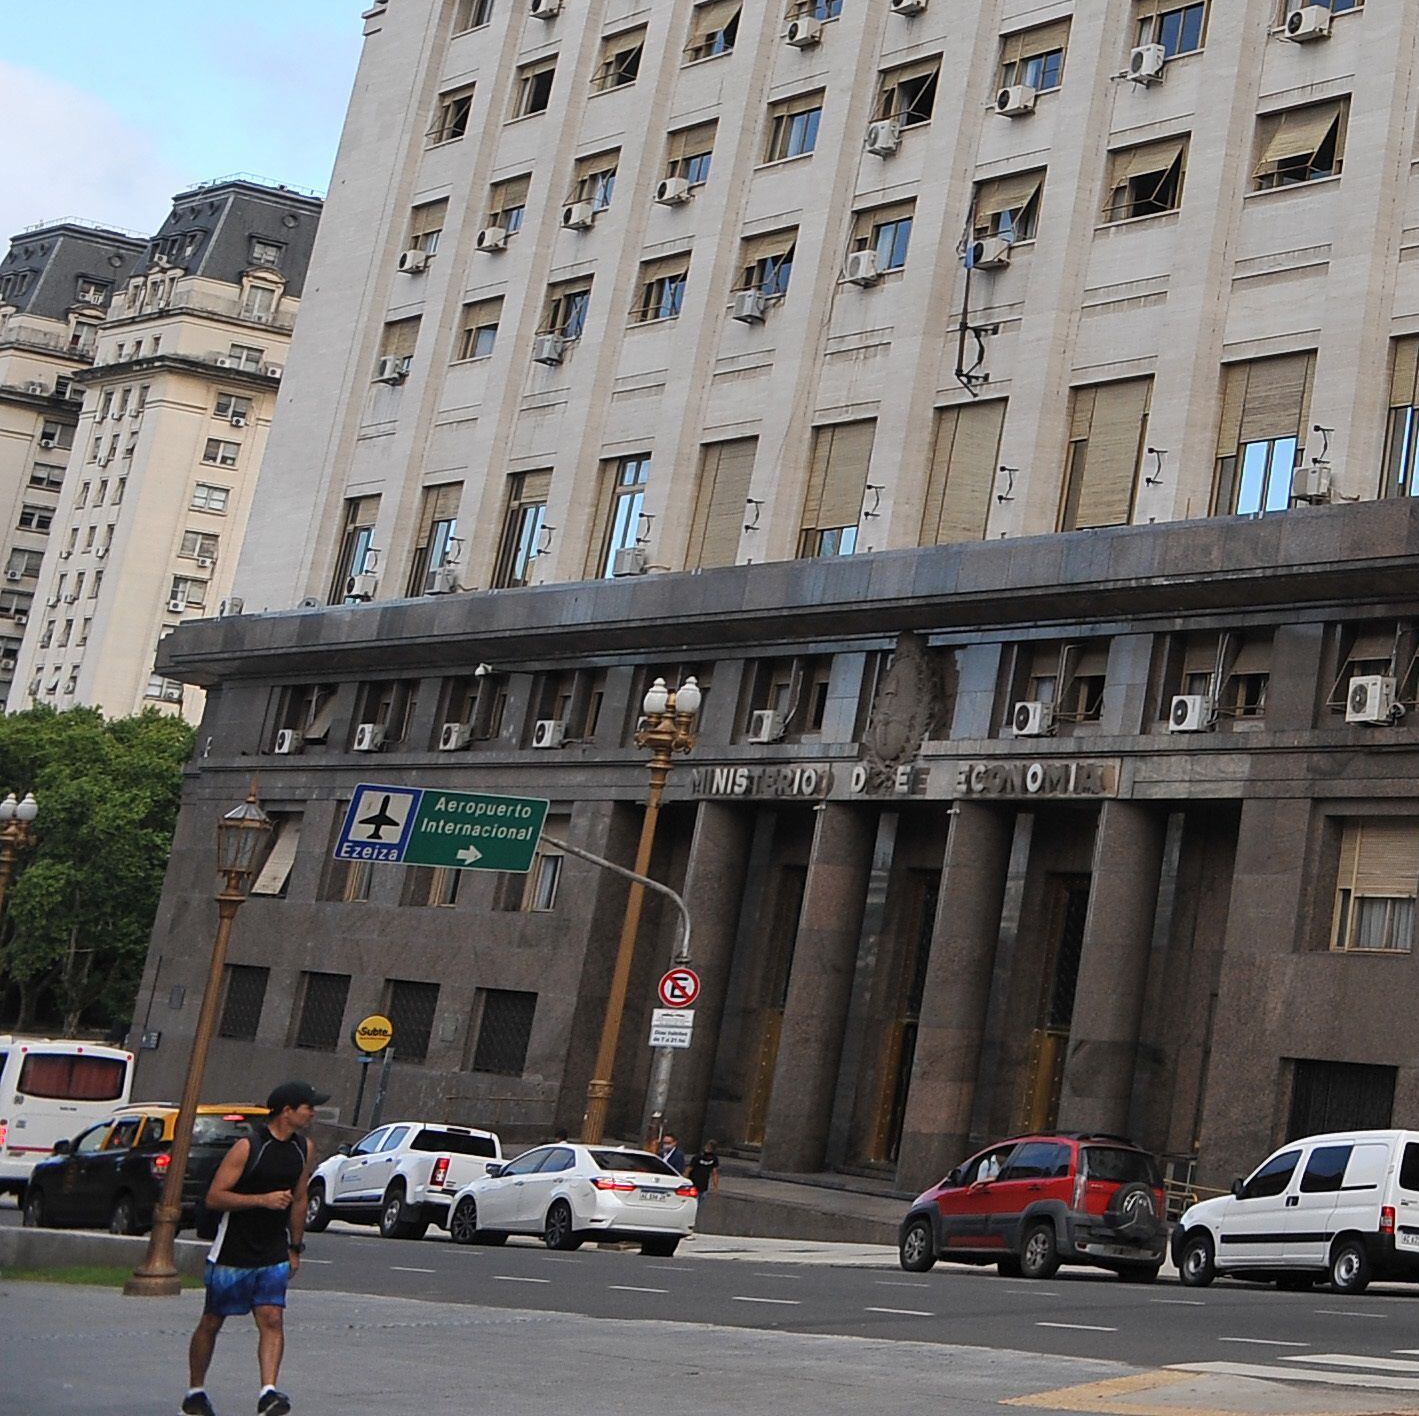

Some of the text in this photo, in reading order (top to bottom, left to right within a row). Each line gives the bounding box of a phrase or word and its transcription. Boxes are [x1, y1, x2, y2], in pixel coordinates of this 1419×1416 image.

[692, 766, 818, 796] MINISTERIO
[851, 765, 912, 794] DE
[434, 796, 532, 819] Aeropuerto
[420, 817, 533, 842] Internacional
[340, 842, 399, 861] Ezeiza
[359, 1026, 389, 1037] Subte
